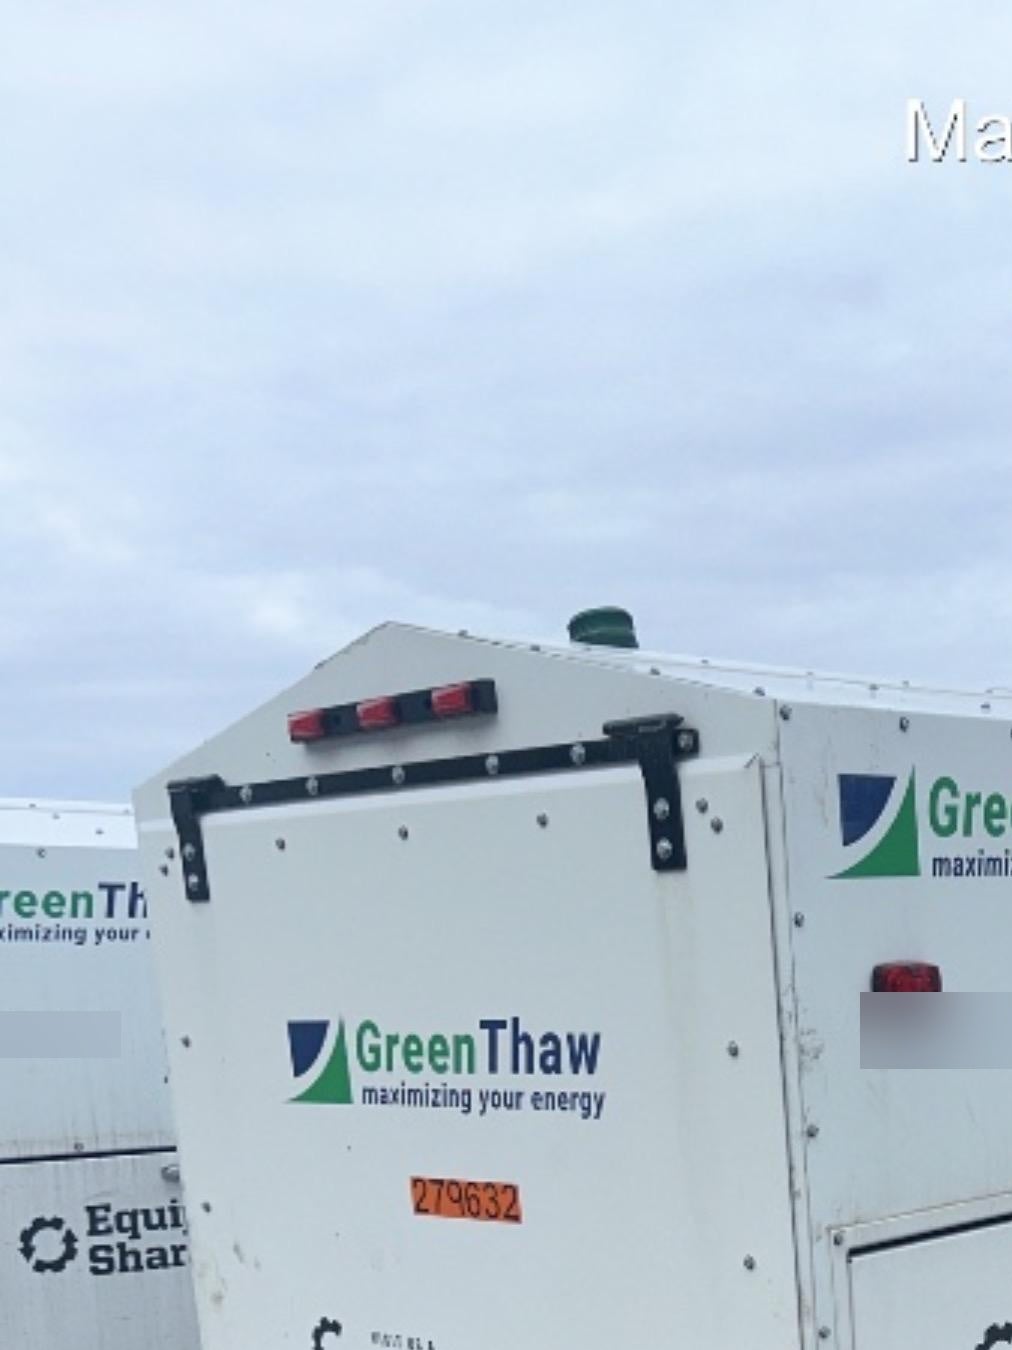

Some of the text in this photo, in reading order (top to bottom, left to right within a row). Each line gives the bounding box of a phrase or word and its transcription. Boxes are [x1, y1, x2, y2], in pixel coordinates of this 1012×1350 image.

[95, 927, 139, 946] your
[356, 1016, 602, 1075] GreenThaw
[362, 1081, 605, 1119] maximizing your energy
[85, 1198, 188, 1240] Equi
[412, 1178, 521, 1222] 279632
